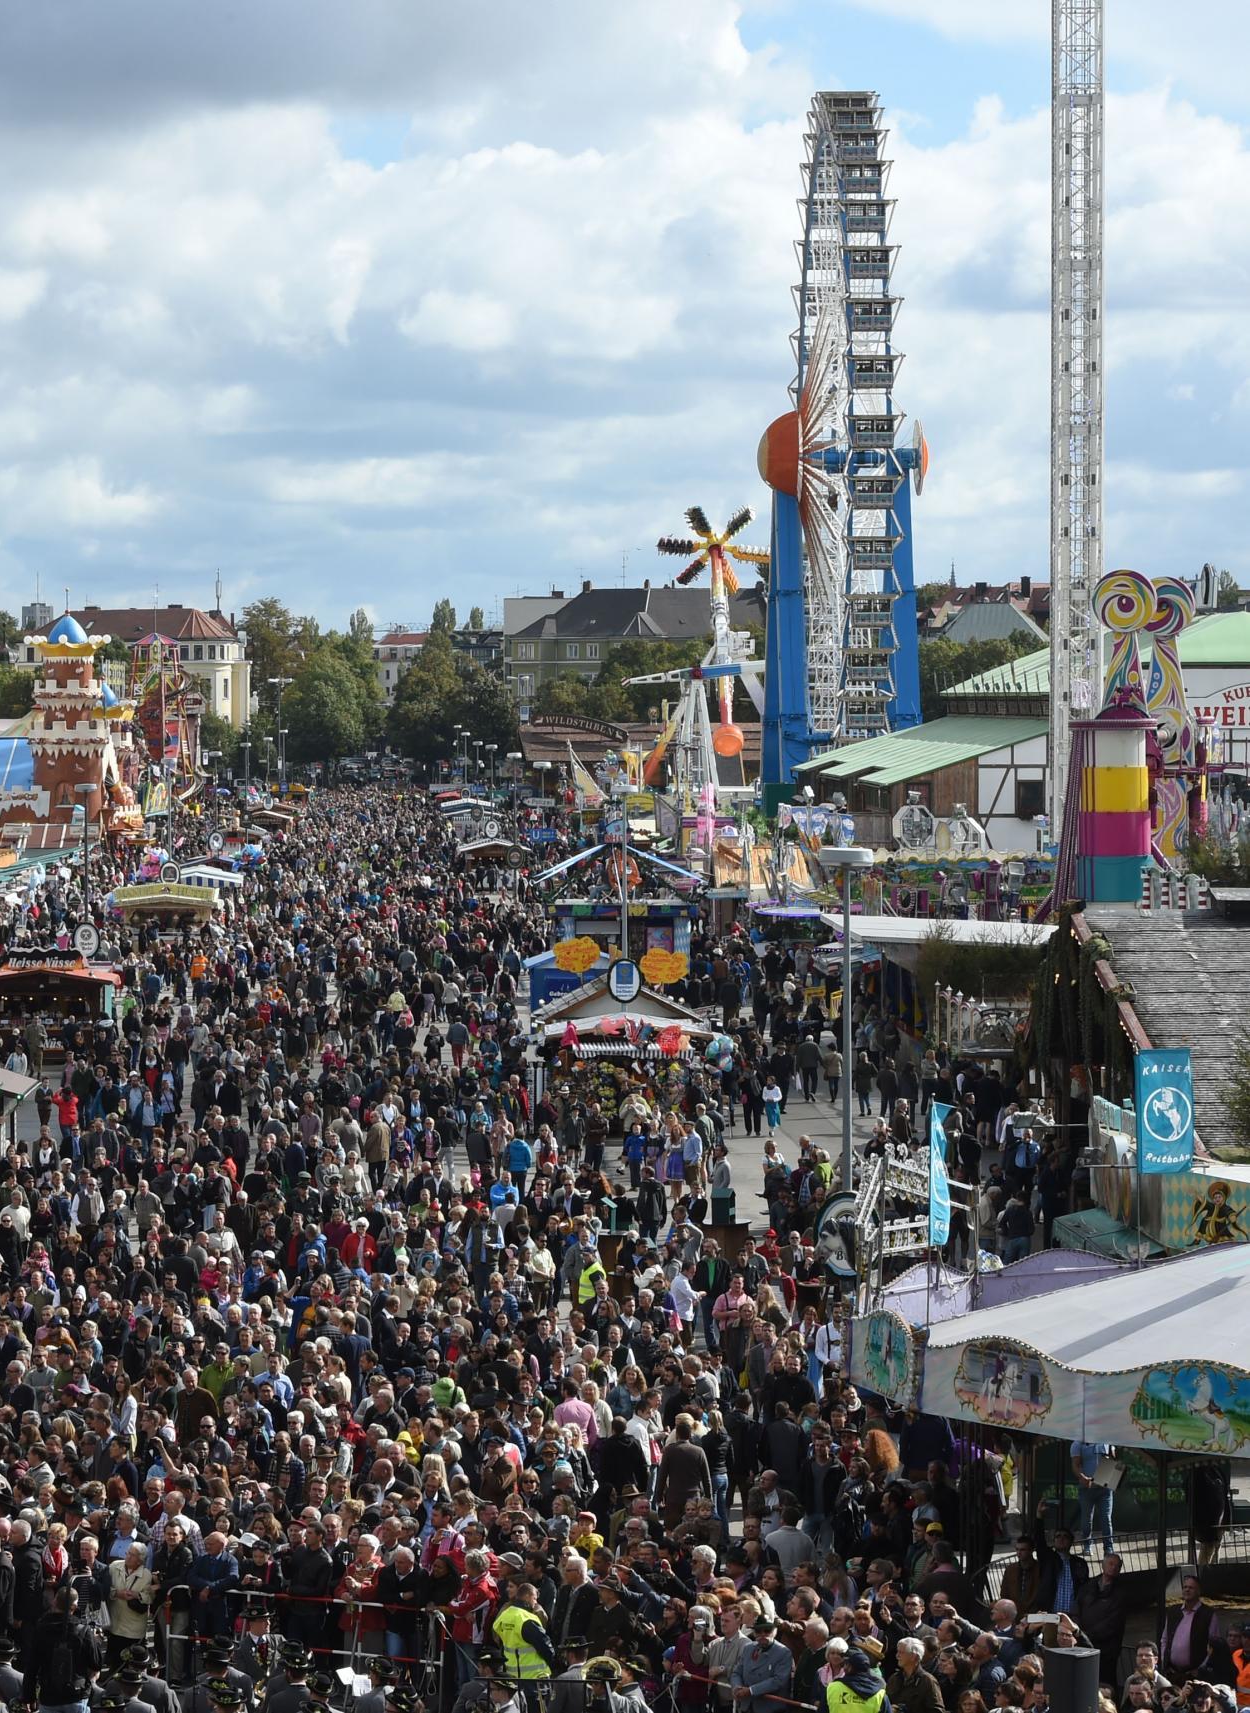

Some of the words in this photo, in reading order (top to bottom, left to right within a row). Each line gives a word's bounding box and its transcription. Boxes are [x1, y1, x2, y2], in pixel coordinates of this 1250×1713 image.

[1194, 706, 1250, 726] WEI
[545, 715, 614, 735] WILDSTUBEN
[532, 829, 540, 839] U
[8, 957, 42, 968] Heisse
[44, 957, 76, 968] Nüsse
[1142, 1064, 1190, 1076] KAISER
[1145, 1152, 1190, 1163] Reitbahn
